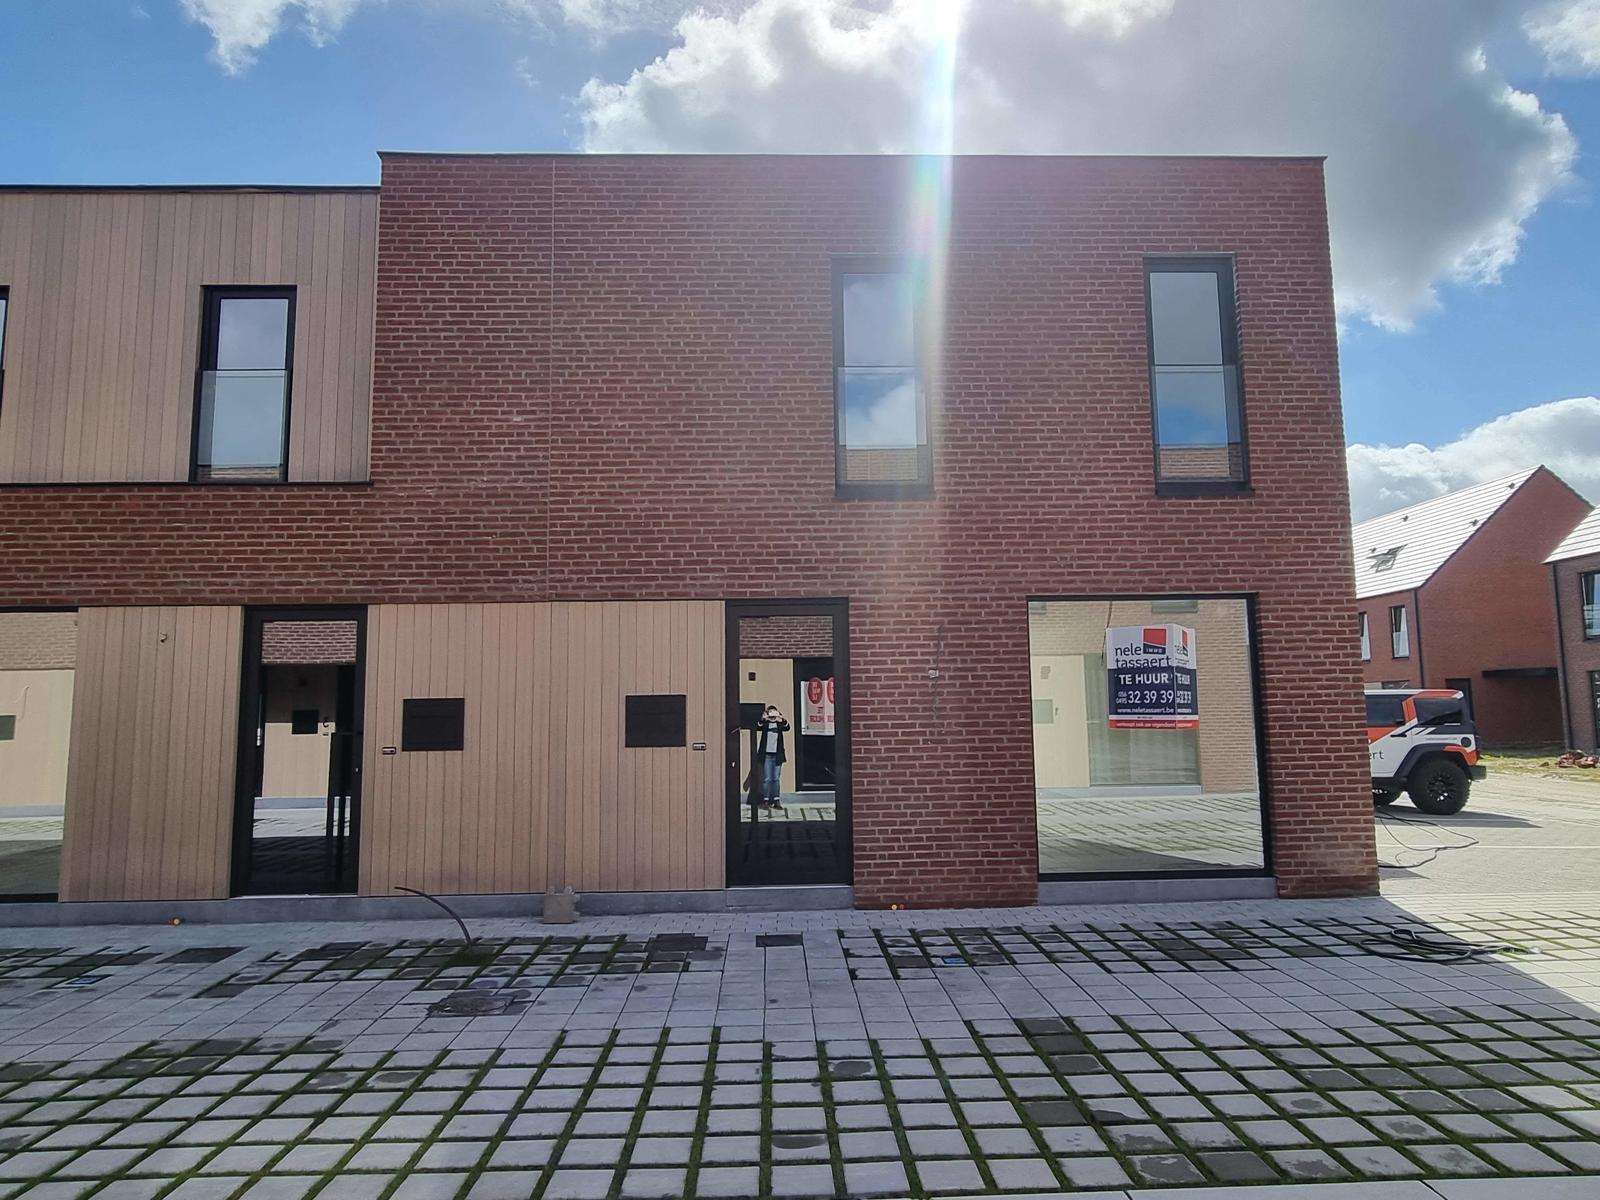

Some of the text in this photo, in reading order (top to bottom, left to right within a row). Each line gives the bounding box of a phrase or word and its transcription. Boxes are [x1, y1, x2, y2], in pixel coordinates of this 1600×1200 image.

[1115, 643, 1142, 656] nele
[1115, 655, 1172, 668] tassaert
[1119, 674, 1169, 684] TE HUUR
[1128, 691, 1141, 703] 32
[1144, 691, 1157, 703] 39
[1160, 690, 1174, 703] 39
